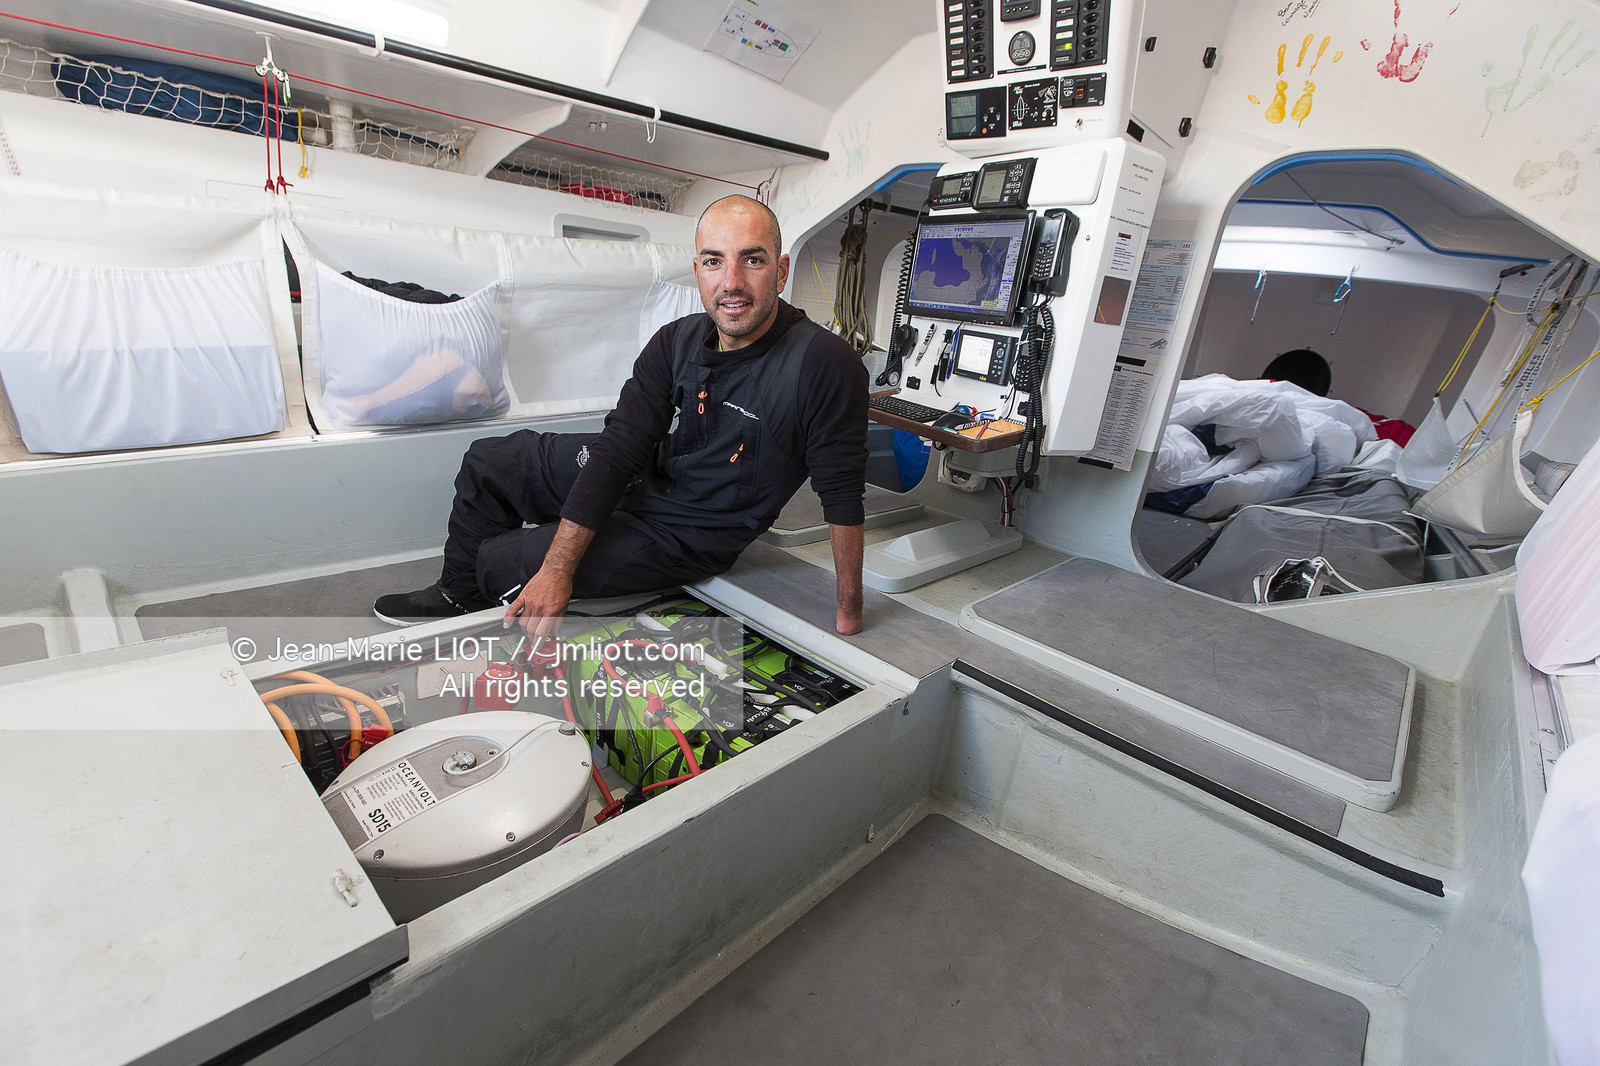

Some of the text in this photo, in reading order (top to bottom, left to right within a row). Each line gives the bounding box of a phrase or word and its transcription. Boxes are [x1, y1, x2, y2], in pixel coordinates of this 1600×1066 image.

[1515, 354, 1541, 389] VOILES
[397, 762, 437, 807] OCEANVOLT
[368, 808, 392, 834] SD15
